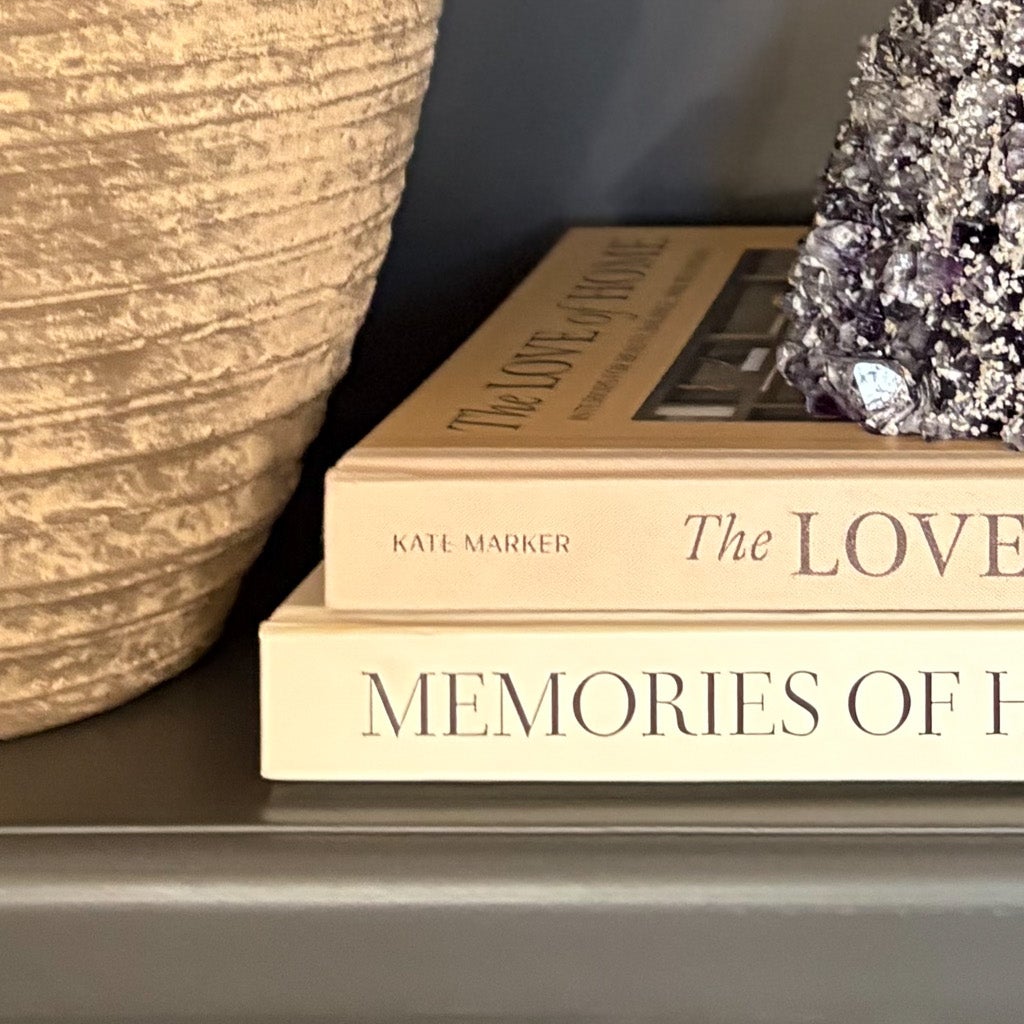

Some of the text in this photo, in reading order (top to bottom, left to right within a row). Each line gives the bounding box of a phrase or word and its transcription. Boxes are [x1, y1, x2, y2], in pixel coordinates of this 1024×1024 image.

[485, 331, 599, 390] LOVE
[447, 394, 543, 431] The
[392, 533, 571, 554] KATE MARKER
[684, 512, 773, 561] The
[361, 670, 820, 738] MEMORIES
[847, 670, 960, 737] OF
